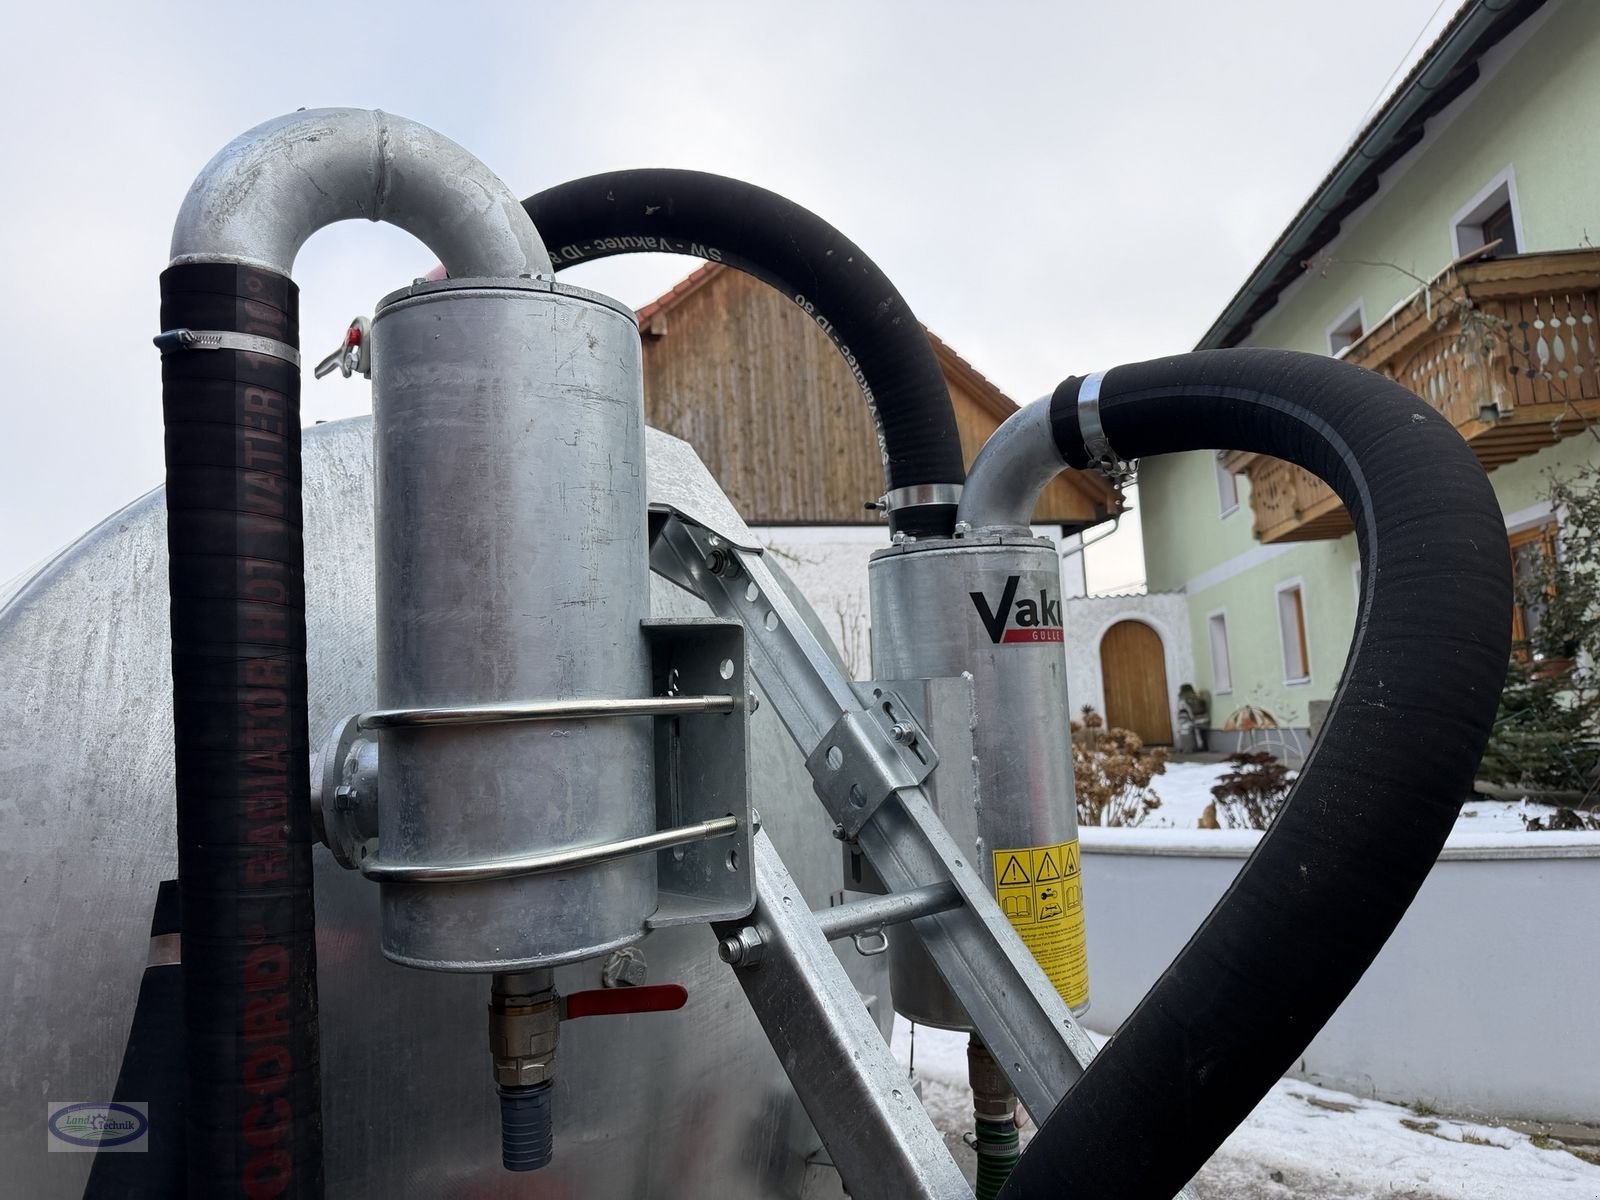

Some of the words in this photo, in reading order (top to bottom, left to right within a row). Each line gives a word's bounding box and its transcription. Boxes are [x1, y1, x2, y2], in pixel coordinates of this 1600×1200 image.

[562, 244, 585, 261] ID
[594, 236, 674, 251] Vakutec
[691, 242, 722, 262] SW
[795, 294, 815, 314] 80
[816, 315, 834, 334] ID
[840, 344, 878, 417] Vakutec
[244, 387, 285, 534] WATER
[245, 556, 288, 640] HOT
[244, 657, 289, 886] RADIATOR
